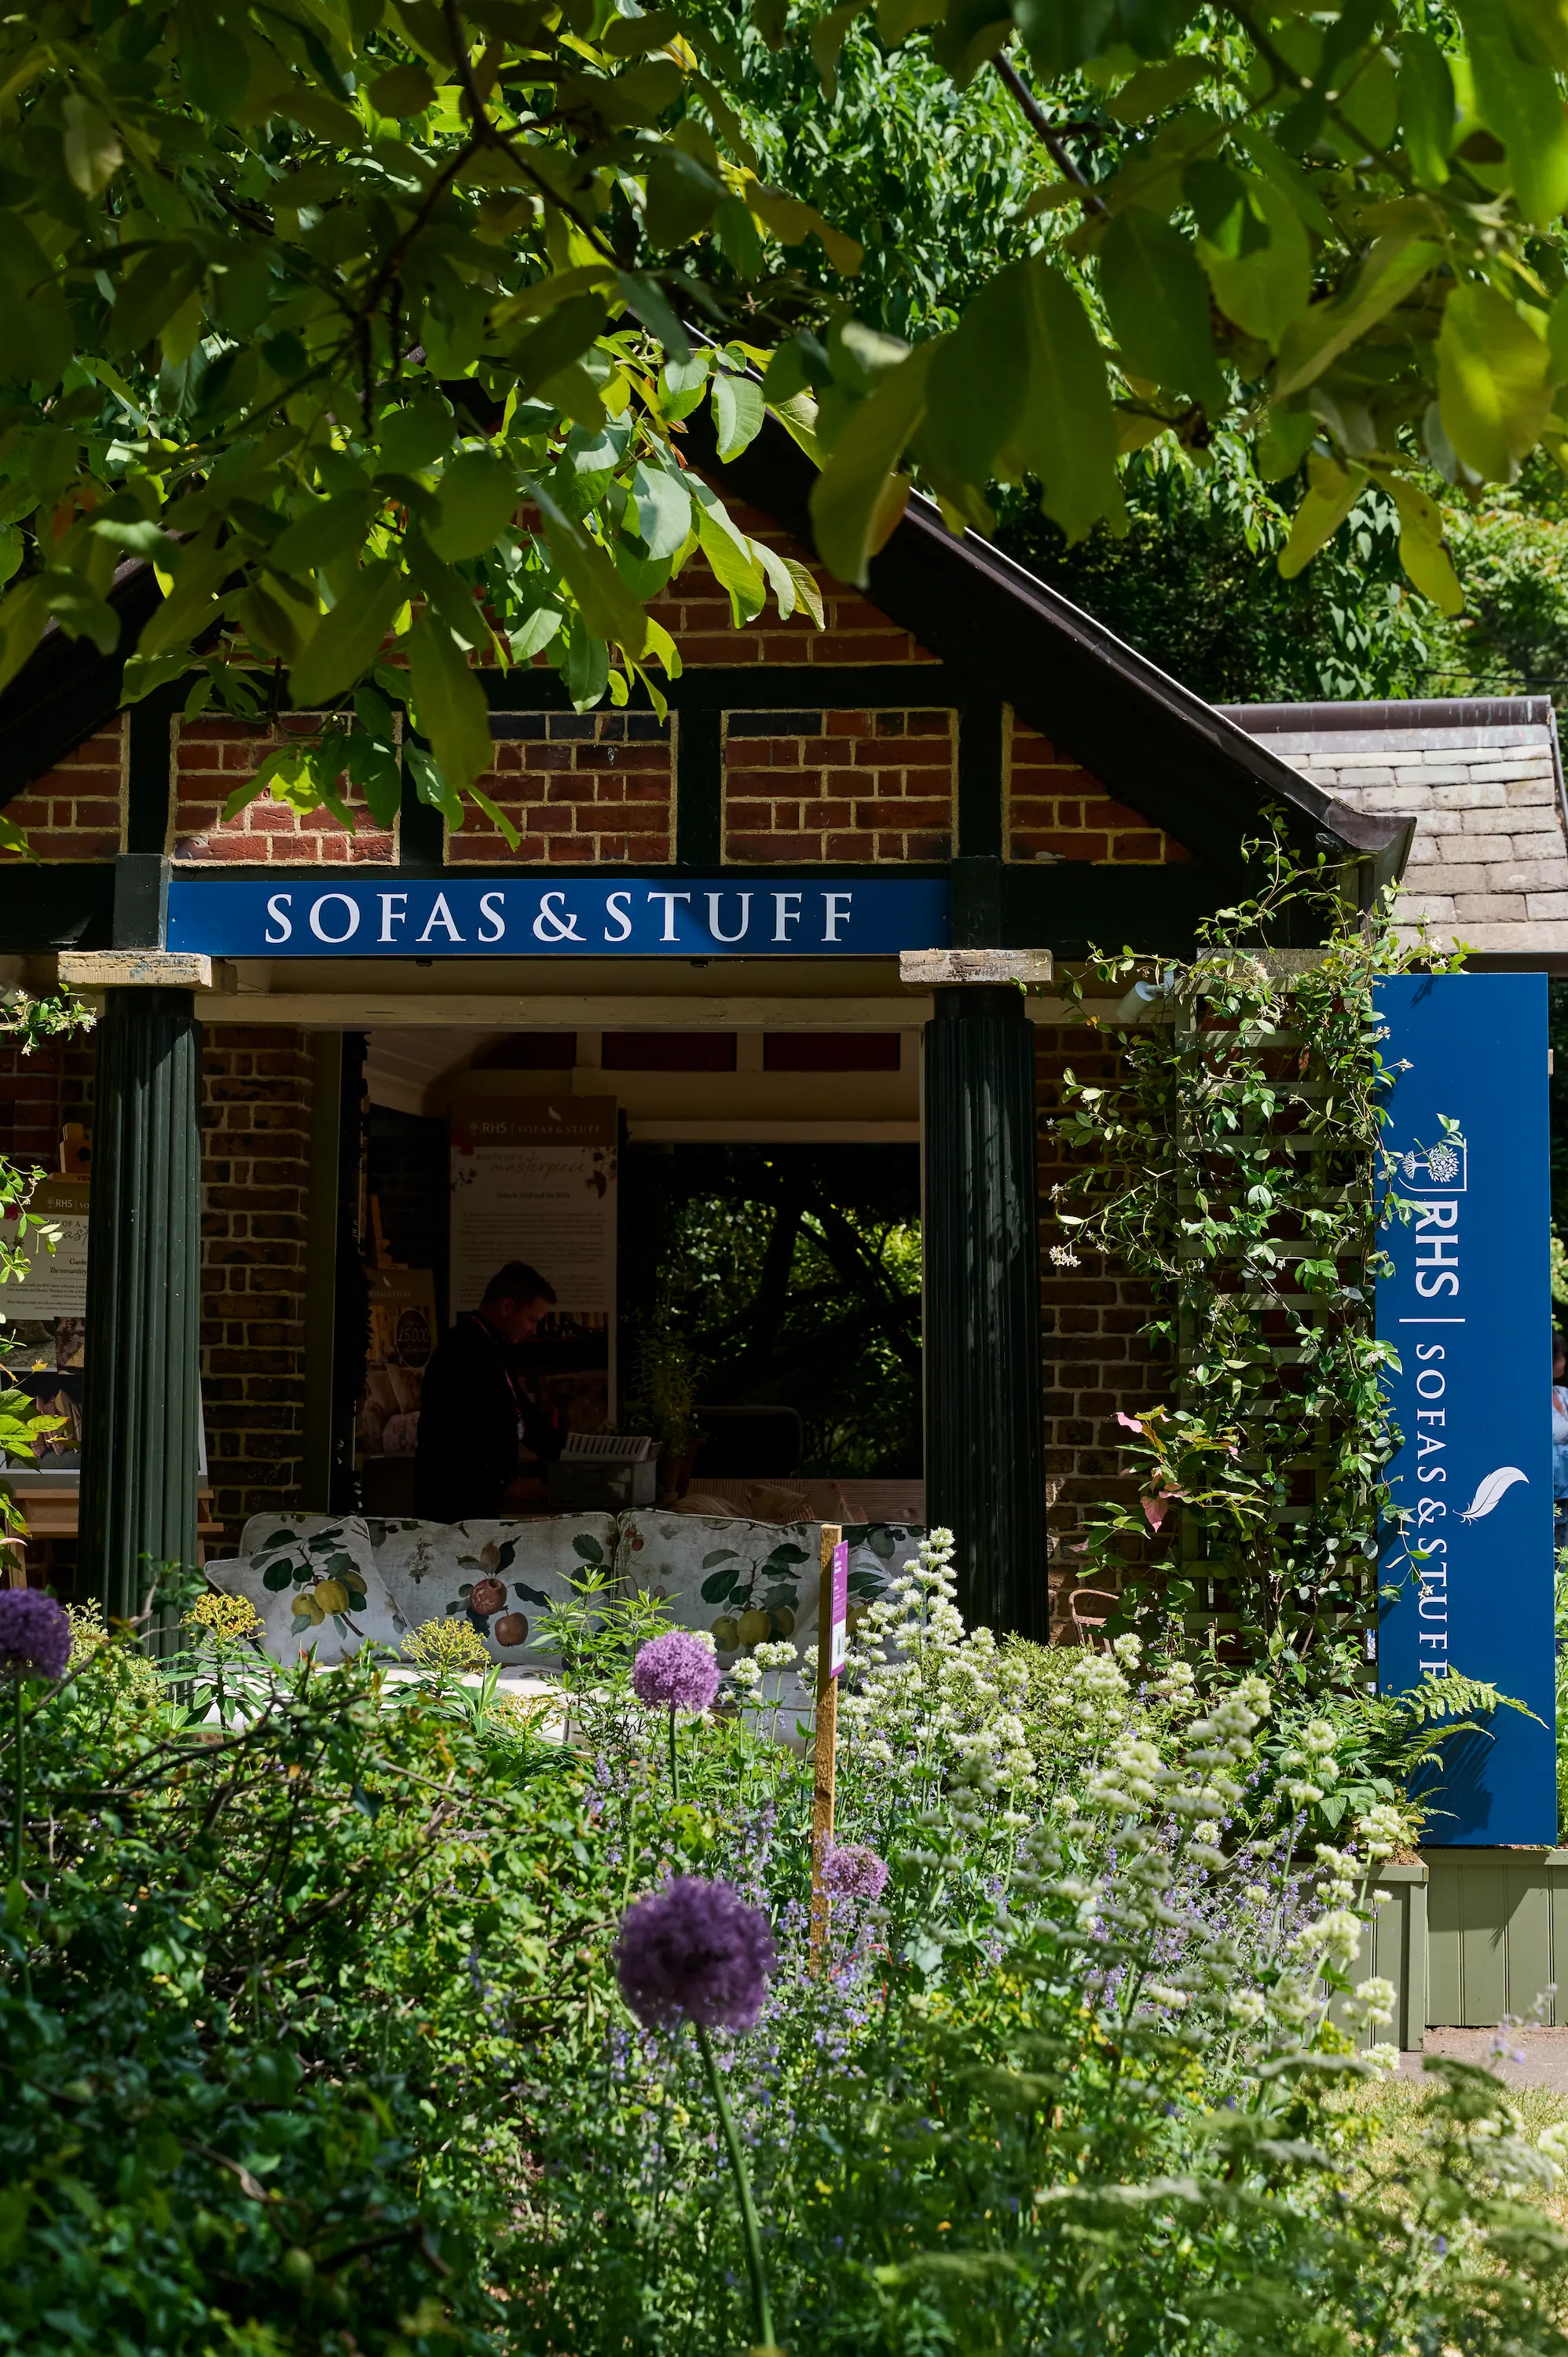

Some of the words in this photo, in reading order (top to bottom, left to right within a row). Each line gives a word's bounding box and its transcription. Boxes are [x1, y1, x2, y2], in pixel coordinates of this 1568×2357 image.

[265, 891, 506, 944] SOFAS
[532, 891, 588, 942] &
[603, 891, 852, 942] STUFF
[482, 1121, 507, 1134] RHS
[56, 1198, 73, 1208] RHS
[1415, 1200, 1460, 1298] RHS
[1416, 1343, 1447, 1483] SOFAS
[1417, 1497, 1447, 1529] &
[1417, 1538, 1448, 1680] STUFF
